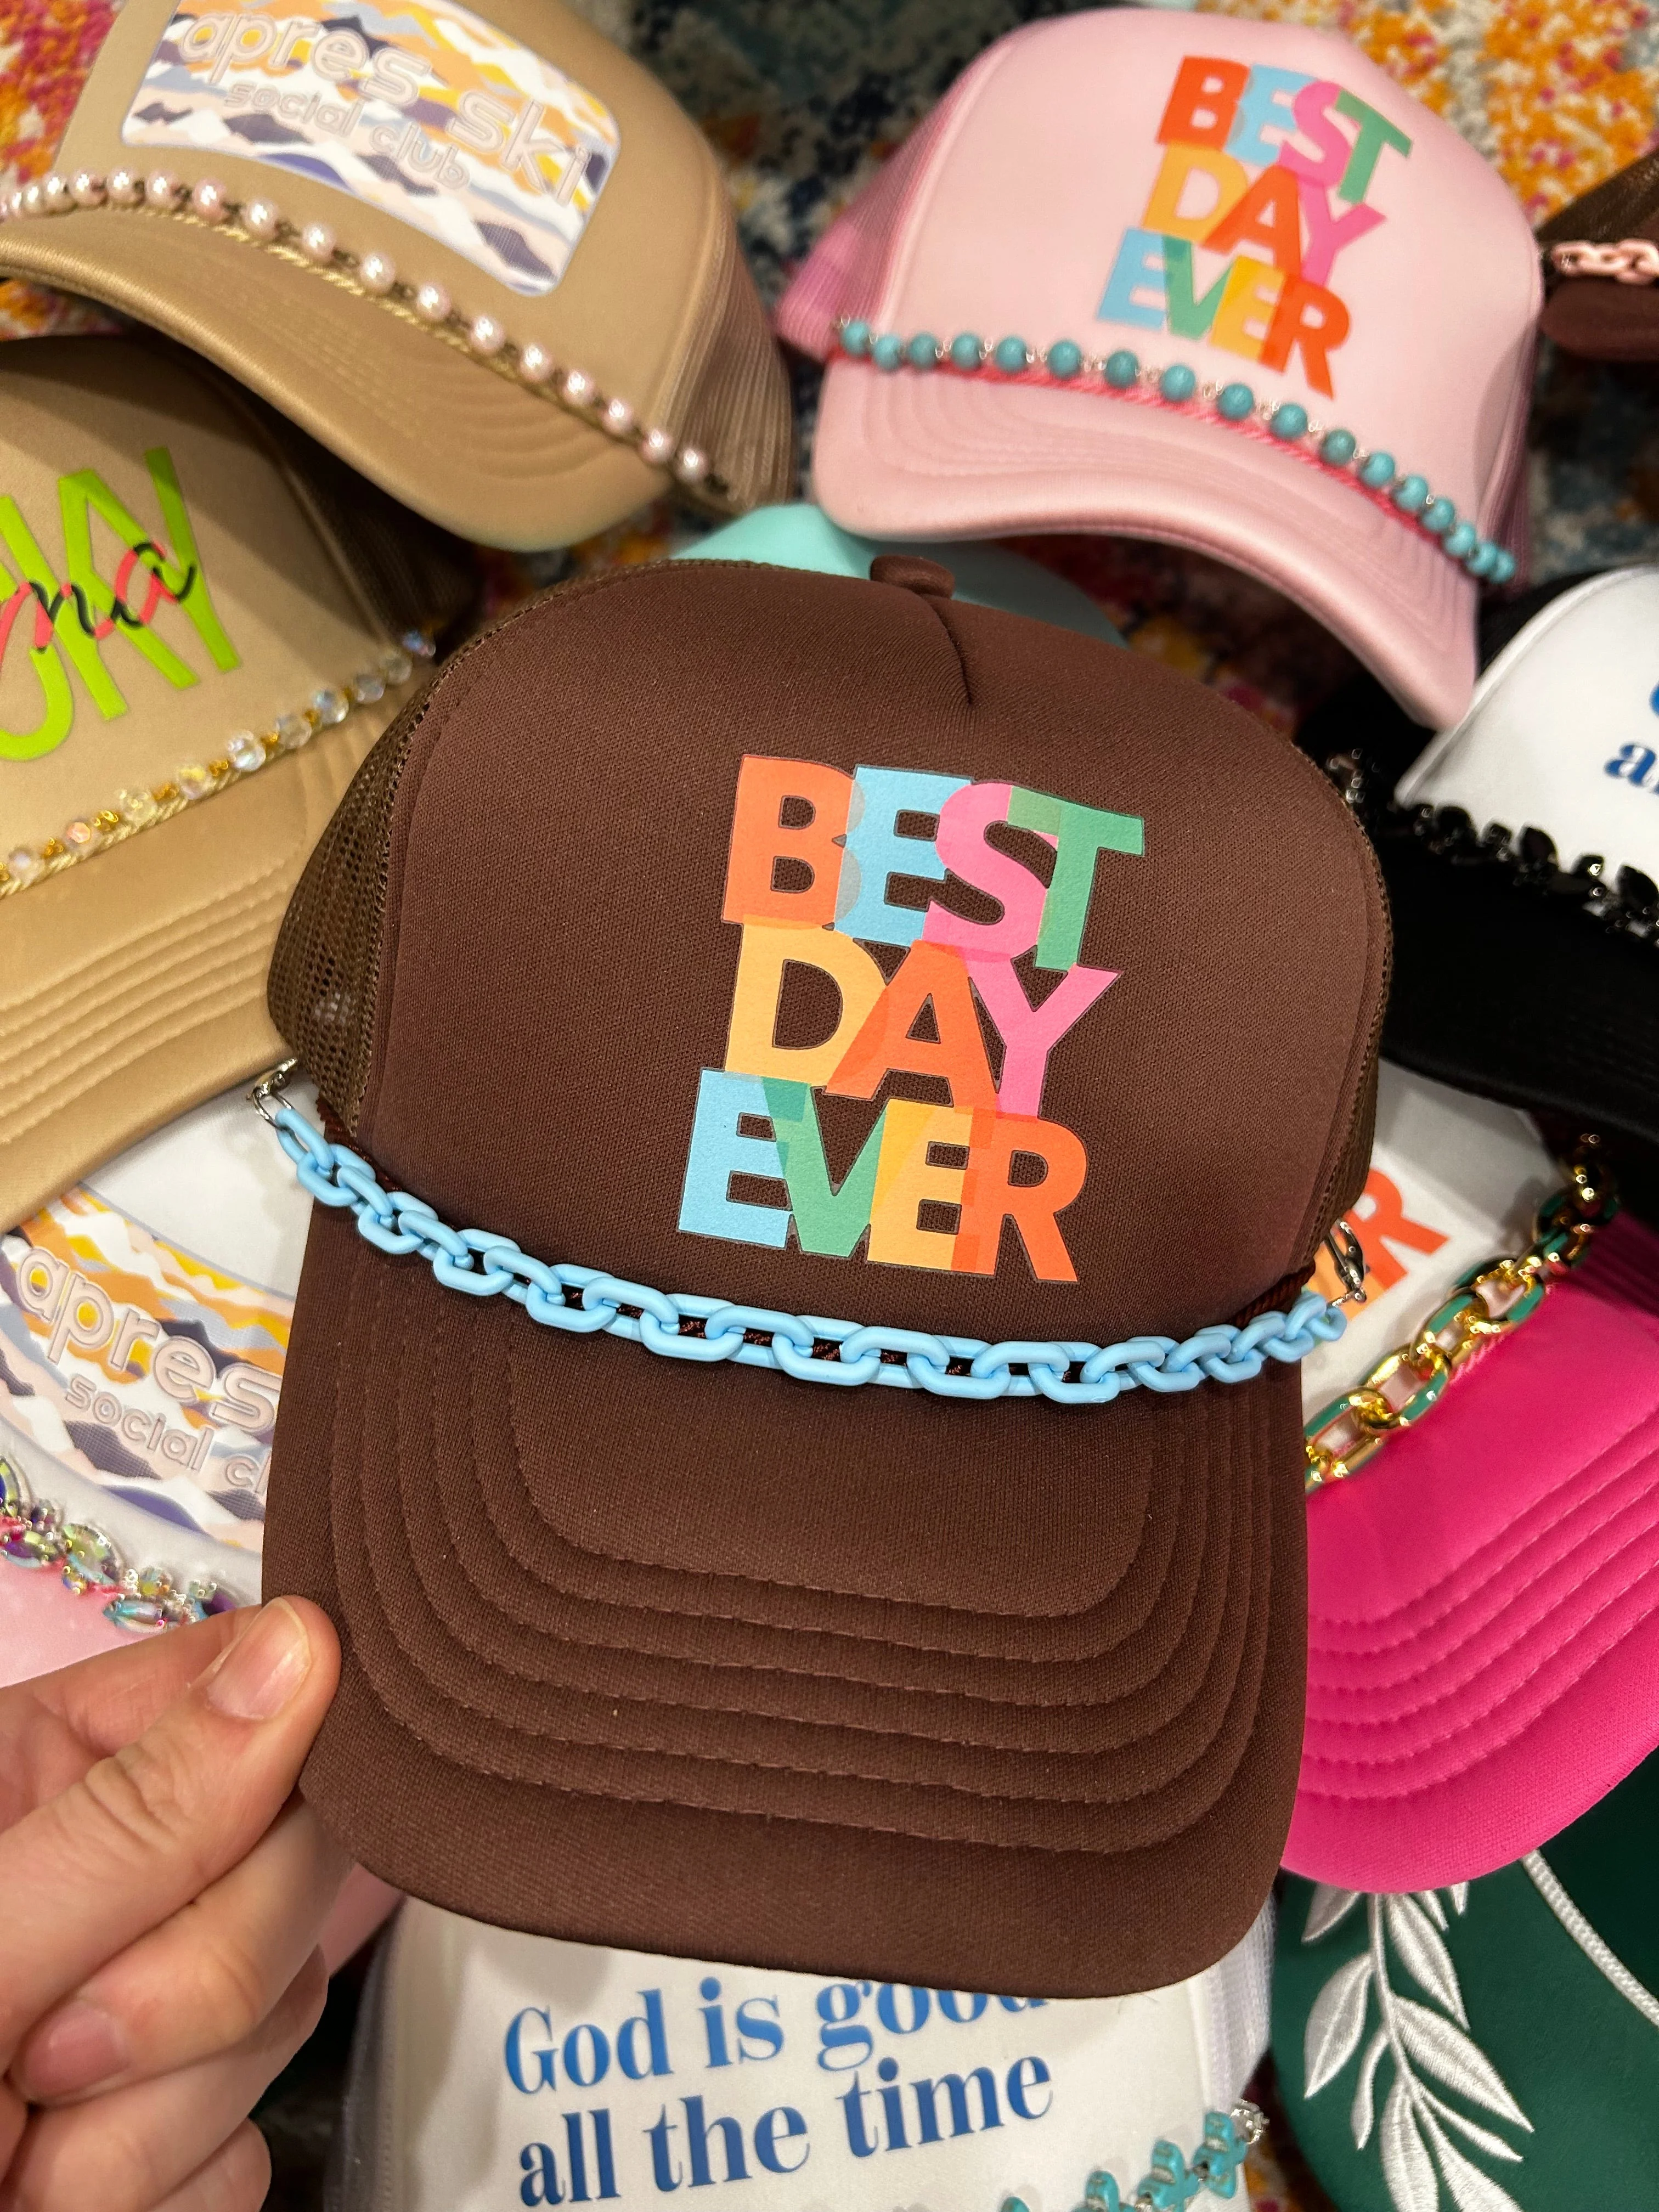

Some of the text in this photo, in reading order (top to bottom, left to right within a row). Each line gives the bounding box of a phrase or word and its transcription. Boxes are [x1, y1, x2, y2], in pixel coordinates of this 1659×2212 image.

[180, 12, 592, 207] apres ski
[224, 81, 470, 190] social club
[1155, 53, 1414, 205] BEST
[1140, 140, 1387, 287] DAY
[1094, 227, 1351, 400] EVER
[721, 753, 1145, 971] BEST
[724, 915, 1123, 1120] DAY
[677, 1066, 1088, 1283] EVER
[16, 1246, 282, 1432] apres
[64, 1374, 214, 1472] social
[503, 1989, 674, 2095] God
[698, 1976, 785, 2069] is
[518, 2056, 1054, 2207] all the time
